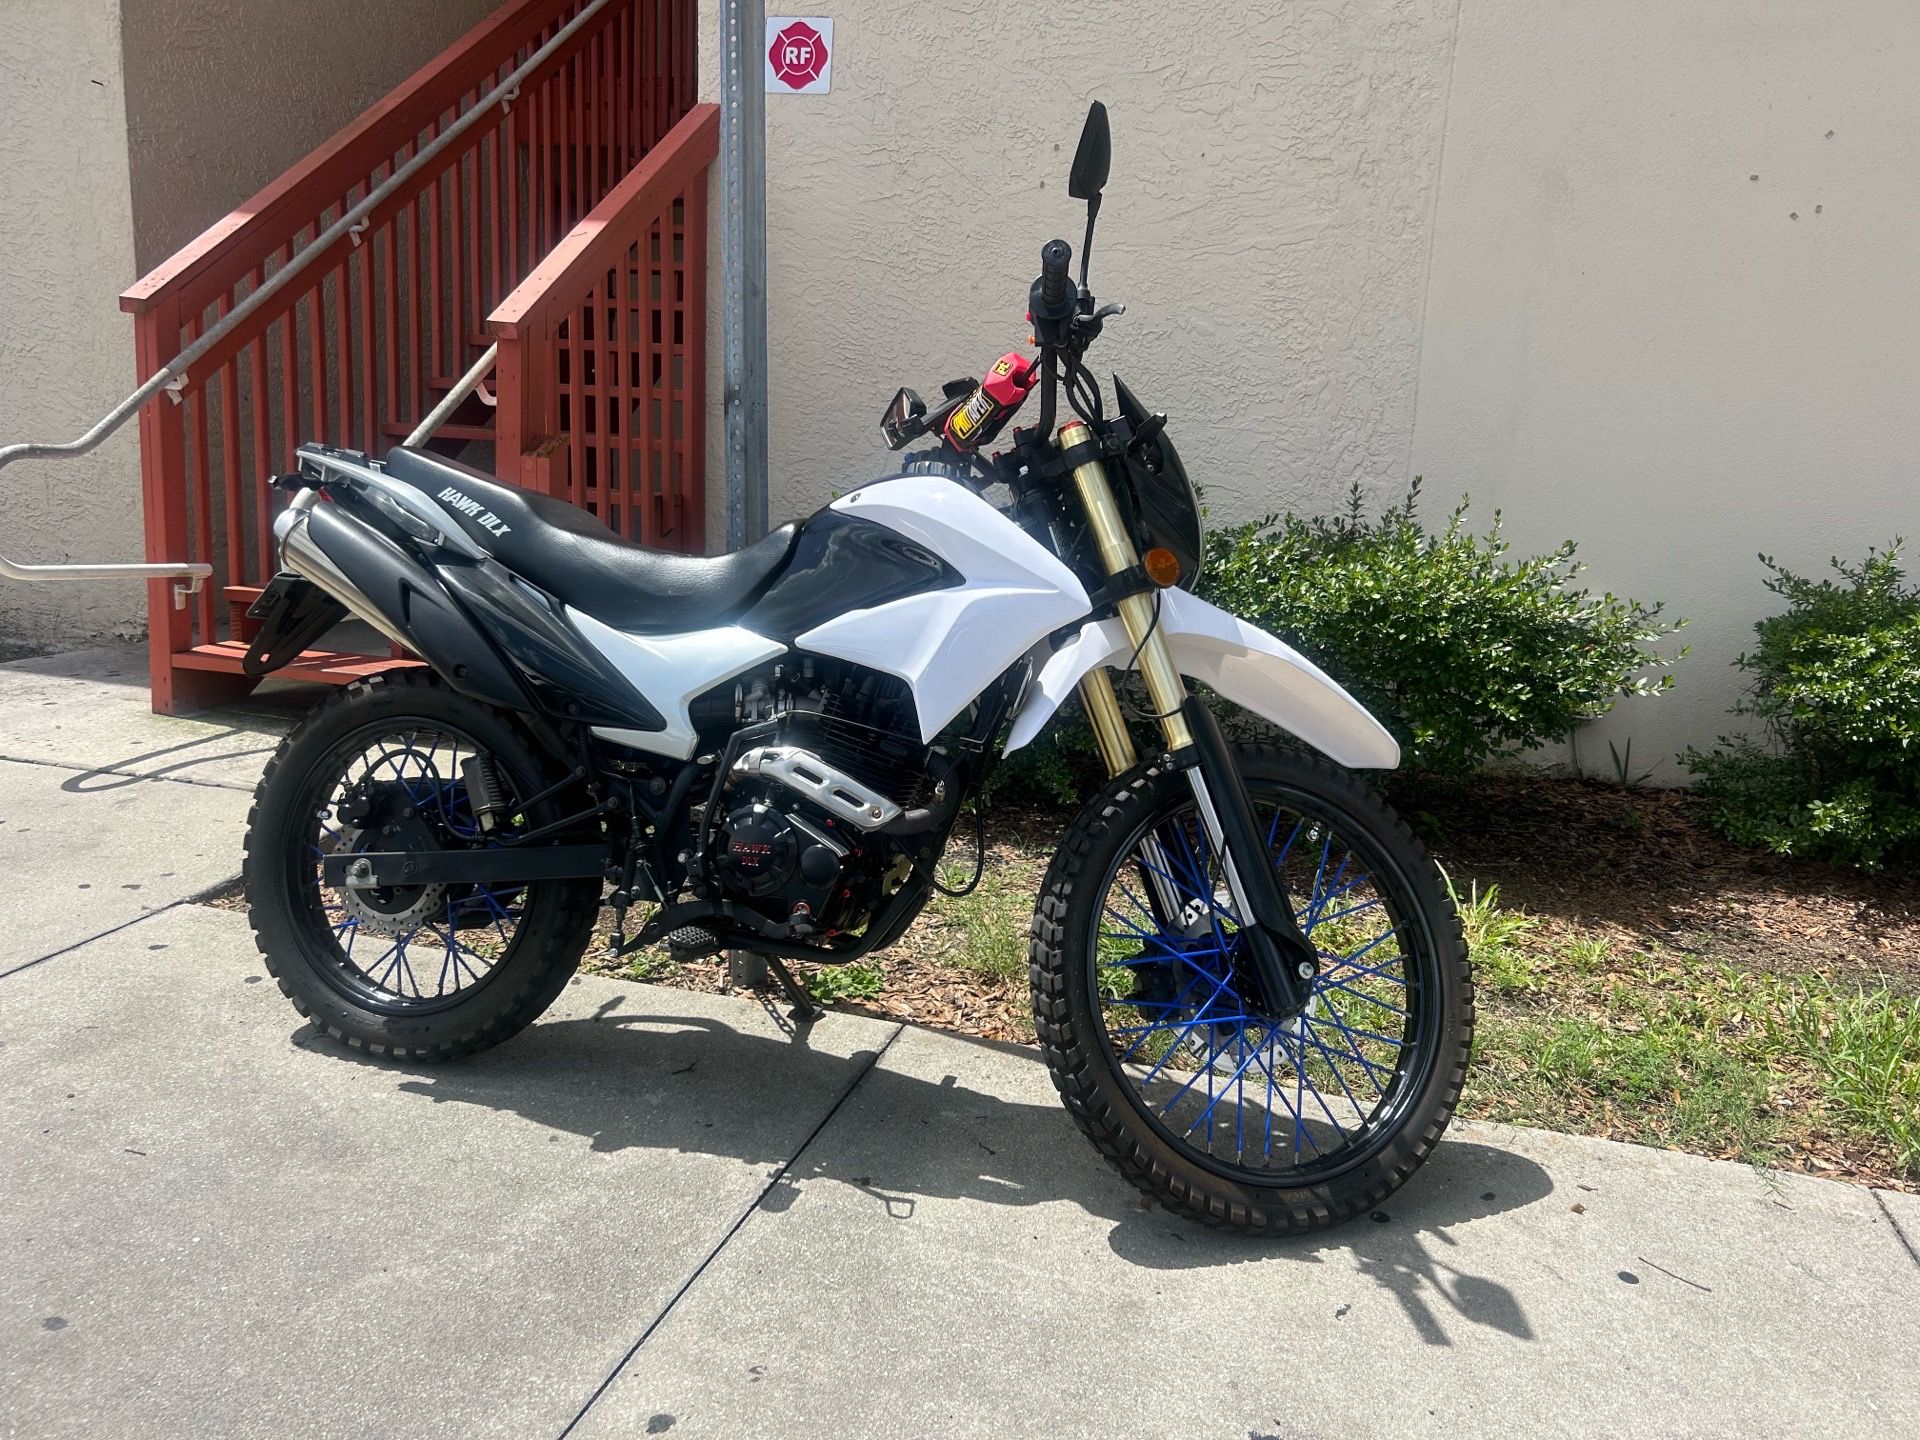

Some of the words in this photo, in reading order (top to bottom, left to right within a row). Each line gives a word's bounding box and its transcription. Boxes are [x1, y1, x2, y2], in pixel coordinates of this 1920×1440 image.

[785, 46, 811, 65] RF
[437, 486, 485, 517] HAWK
[477, 511, 512, 538] DLX
